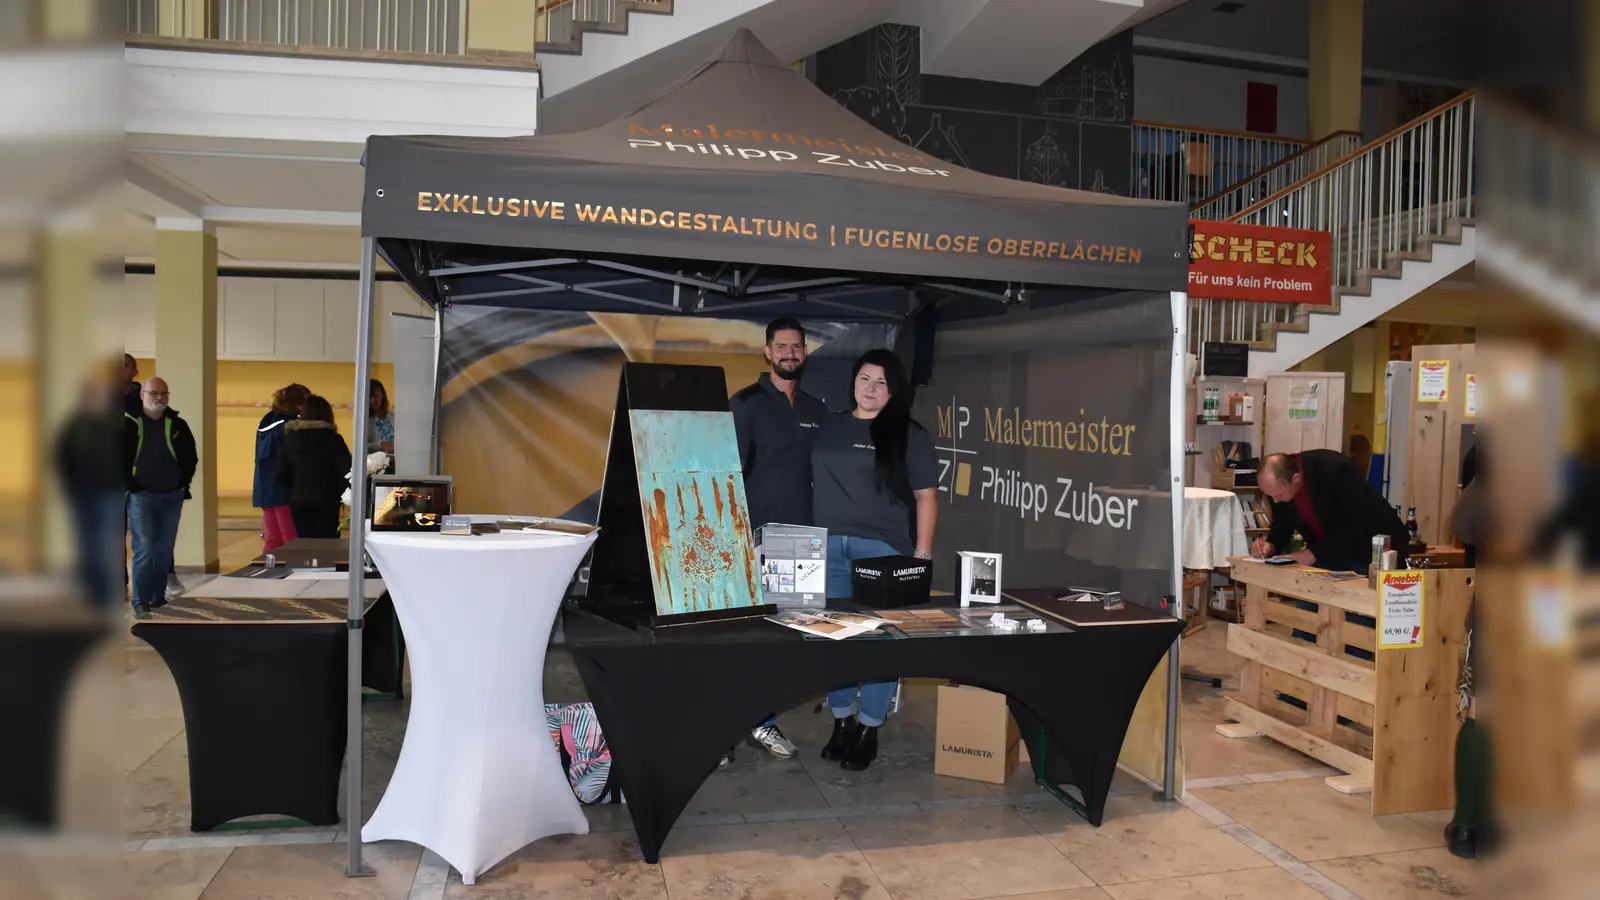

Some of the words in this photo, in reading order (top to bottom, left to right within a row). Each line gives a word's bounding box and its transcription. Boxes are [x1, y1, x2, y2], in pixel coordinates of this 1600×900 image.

[627, 138, 798, 162] Philipp
[812, 151, 950, 178] Zuber
[628, 122, 931, 164] Malermeister
[417, 191, 565, 220] EXKLUSIVE
[574, 203, 818, 241] WANDGESTALTUNG
[845, 227, 979, 254] FUGENLOSE
[987, 237, 1142, 265] OBERFLÄCHEN
[1193, 233, 1318, 268] SCHECK
[1188, 271, 1208, 284] Für
[1211, 275, 1233, 286] uns
[1237, 275, 1260, 288] kein
[1264, 277, 1312, 291] Problem
[984, 406, 1136, 456] Malermeister
[981, 466, 1047, 521] Philipp
[1054, 477, 1138, 530] Zuber
[942, 744, 993, 759] LAMURISTA
